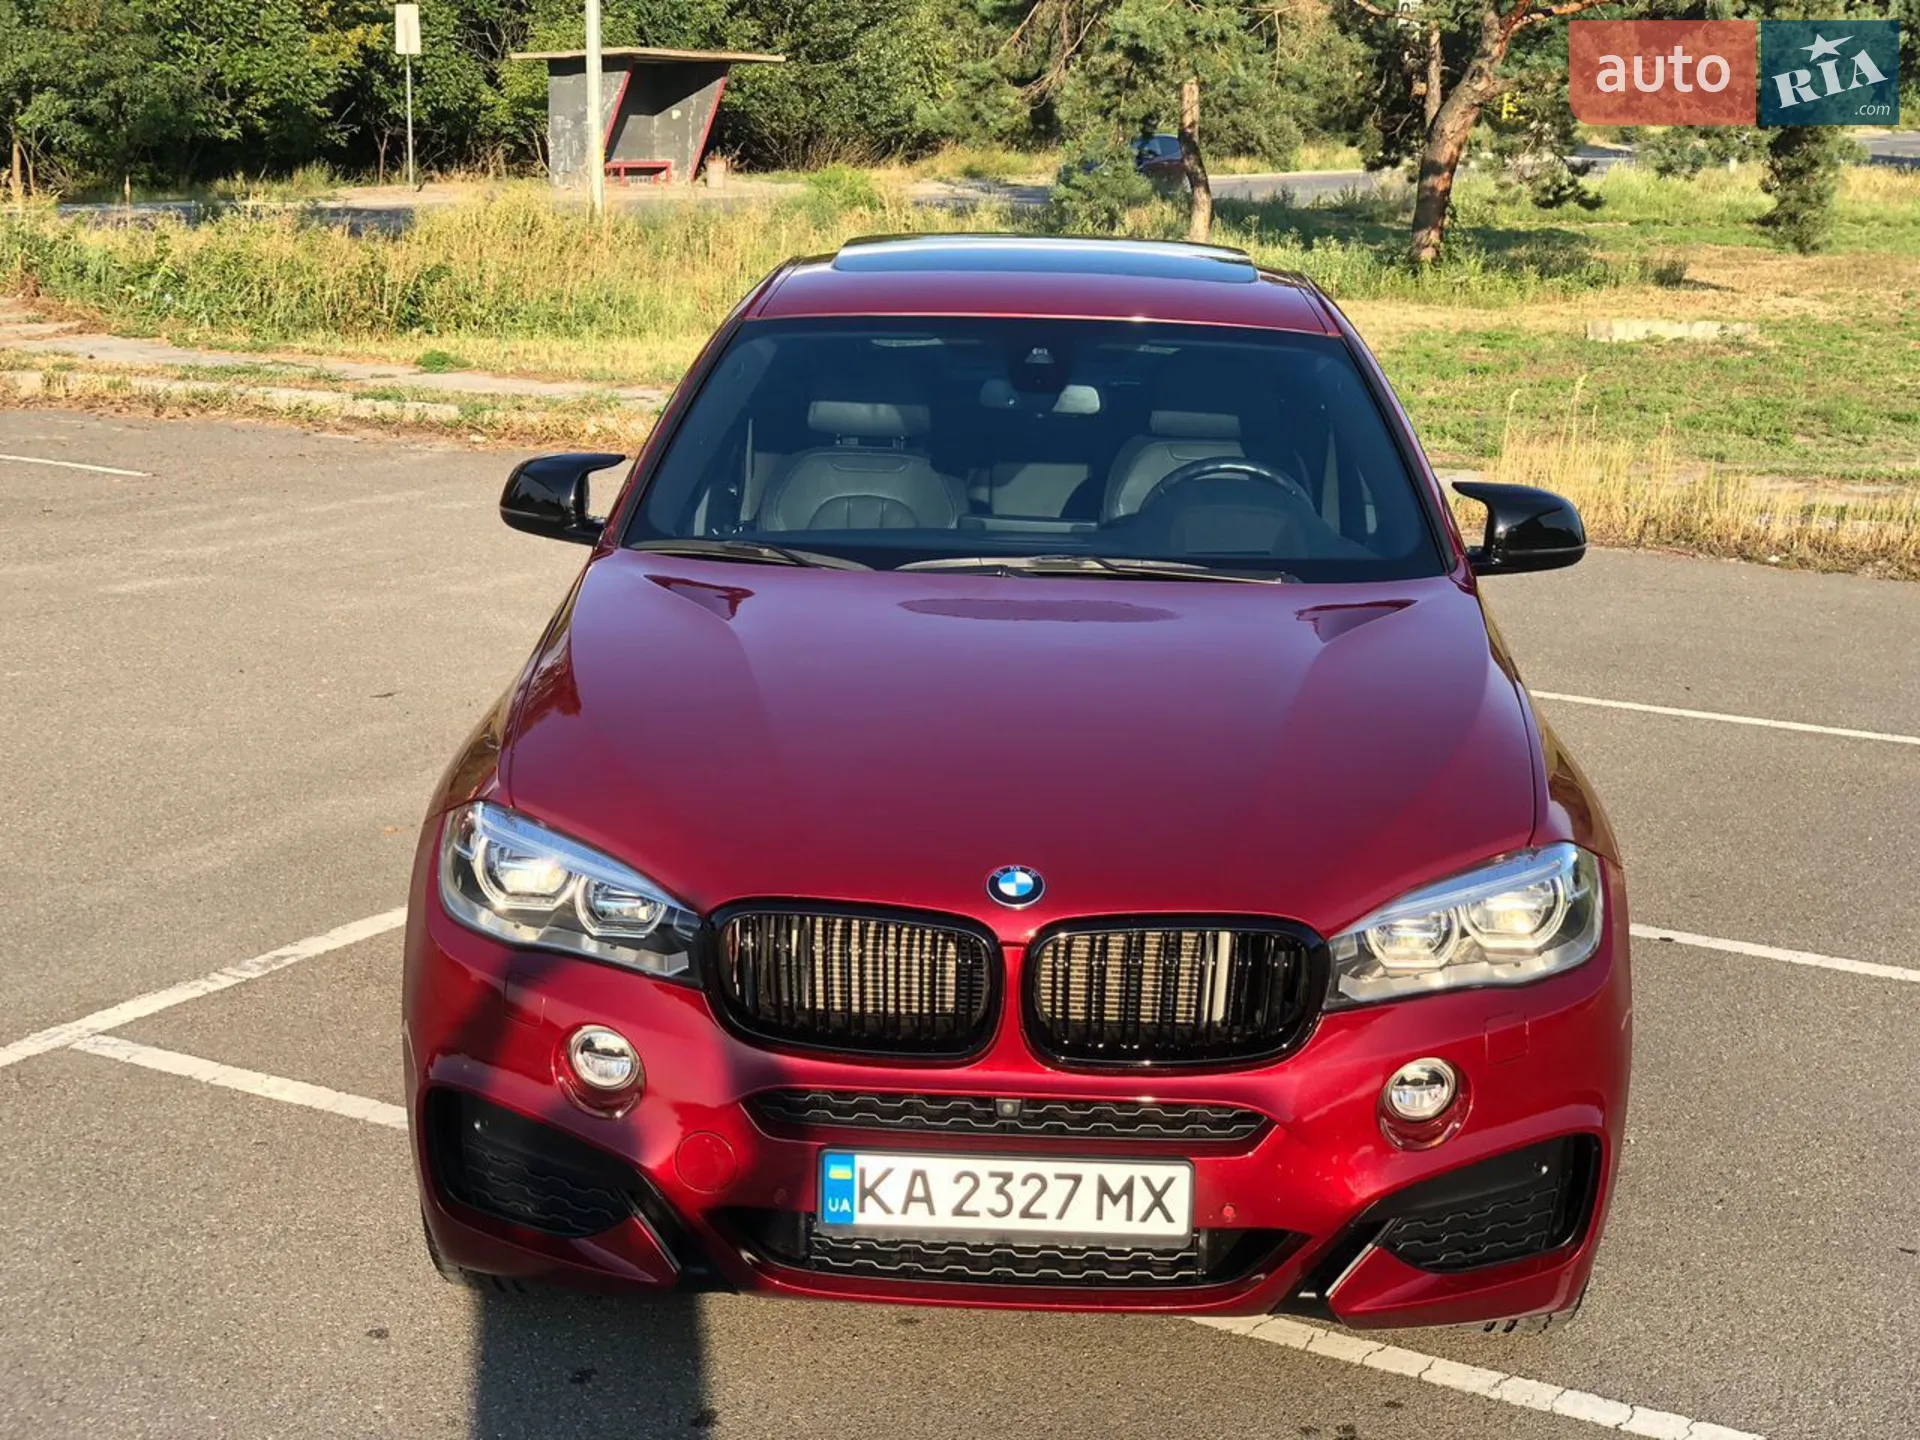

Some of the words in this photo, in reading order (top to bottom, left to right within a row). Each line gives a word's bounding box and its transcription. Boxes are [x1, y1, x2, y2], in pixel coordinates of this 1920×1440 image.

[828, 1198, 851, 1213] UA
[858, 1167, 936, 1216] KA
[951, 1171, 1083, 1221] 2327
[1096, 1175, 1175, 1223] MX
